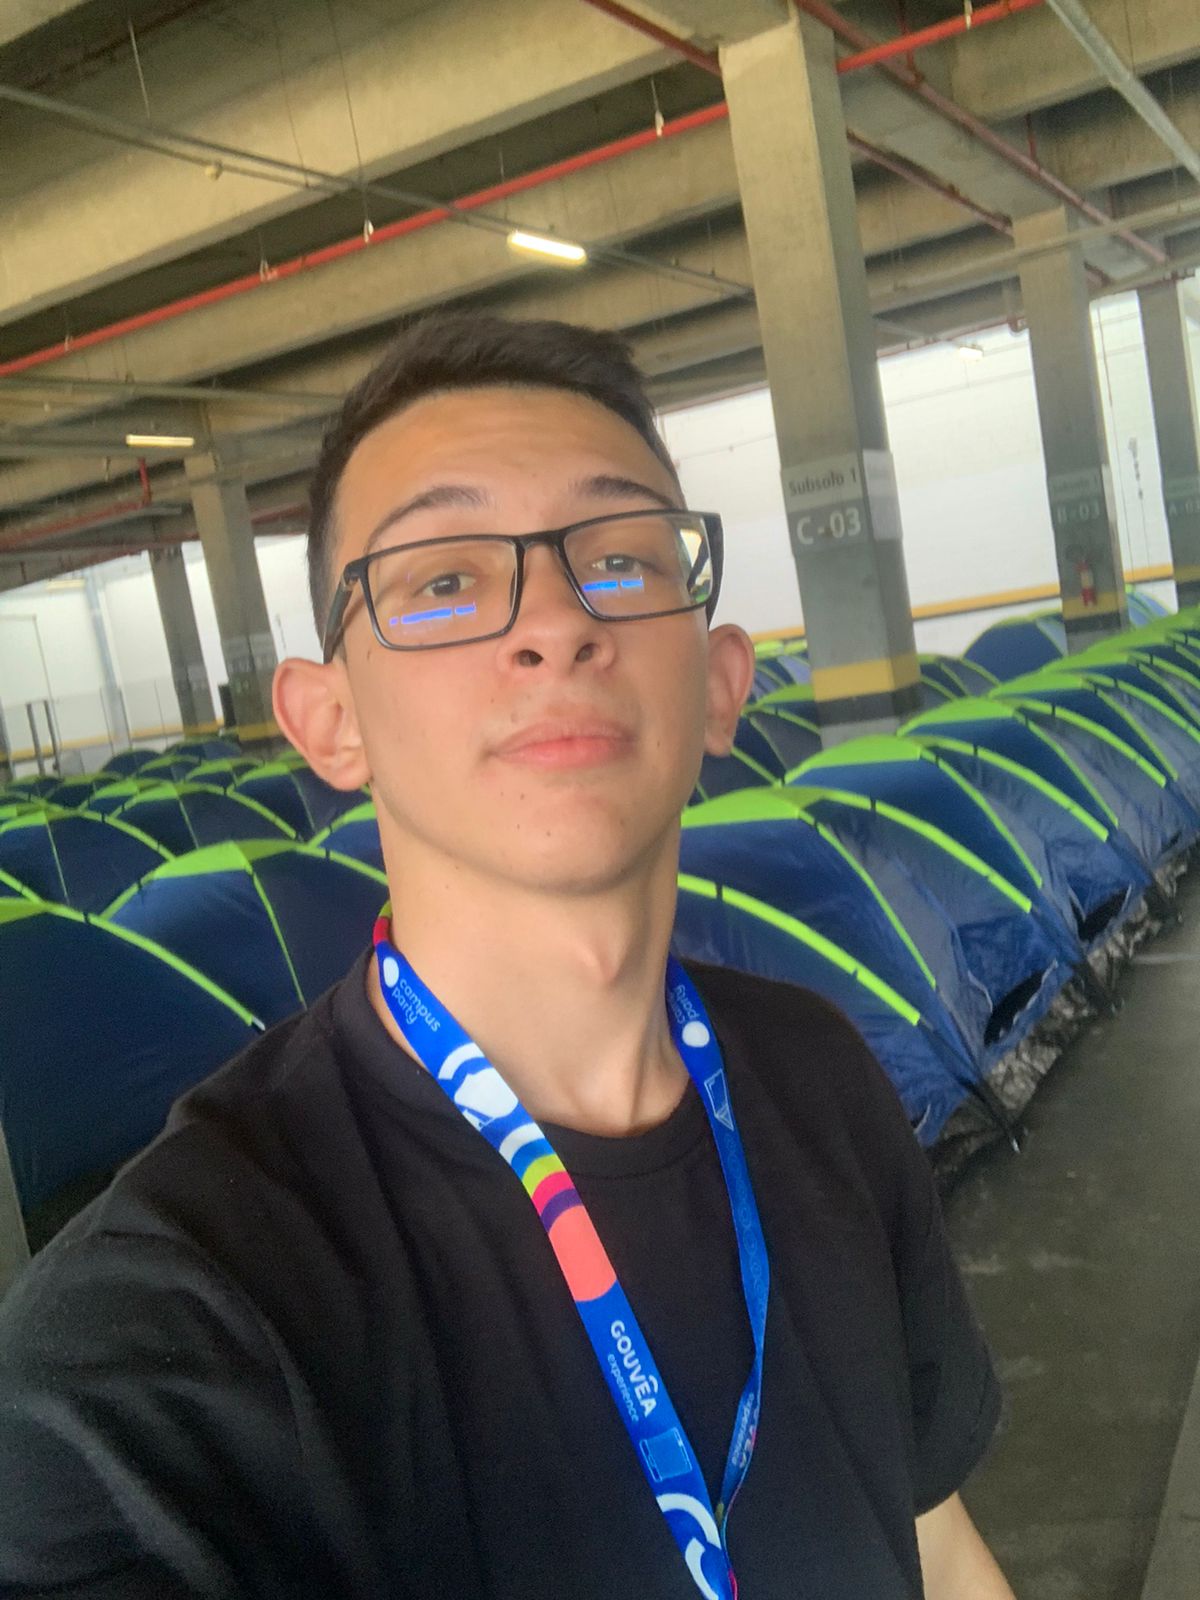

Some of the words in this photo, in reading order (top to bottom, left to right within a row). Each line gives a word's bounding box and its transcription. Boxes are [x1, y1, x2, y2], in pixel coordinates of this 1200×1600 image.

[788, 470, 845, 496] Subsolo
[850, 467, 857, 483] 1
[391, 986, 418, 1025] party
[399, 978, 441, 1032] campus
[674, 984, 700, 1020] party
[607, 1353, 640, 1422] experience
[610, 1319, 659, 1418] GOUVÊA
